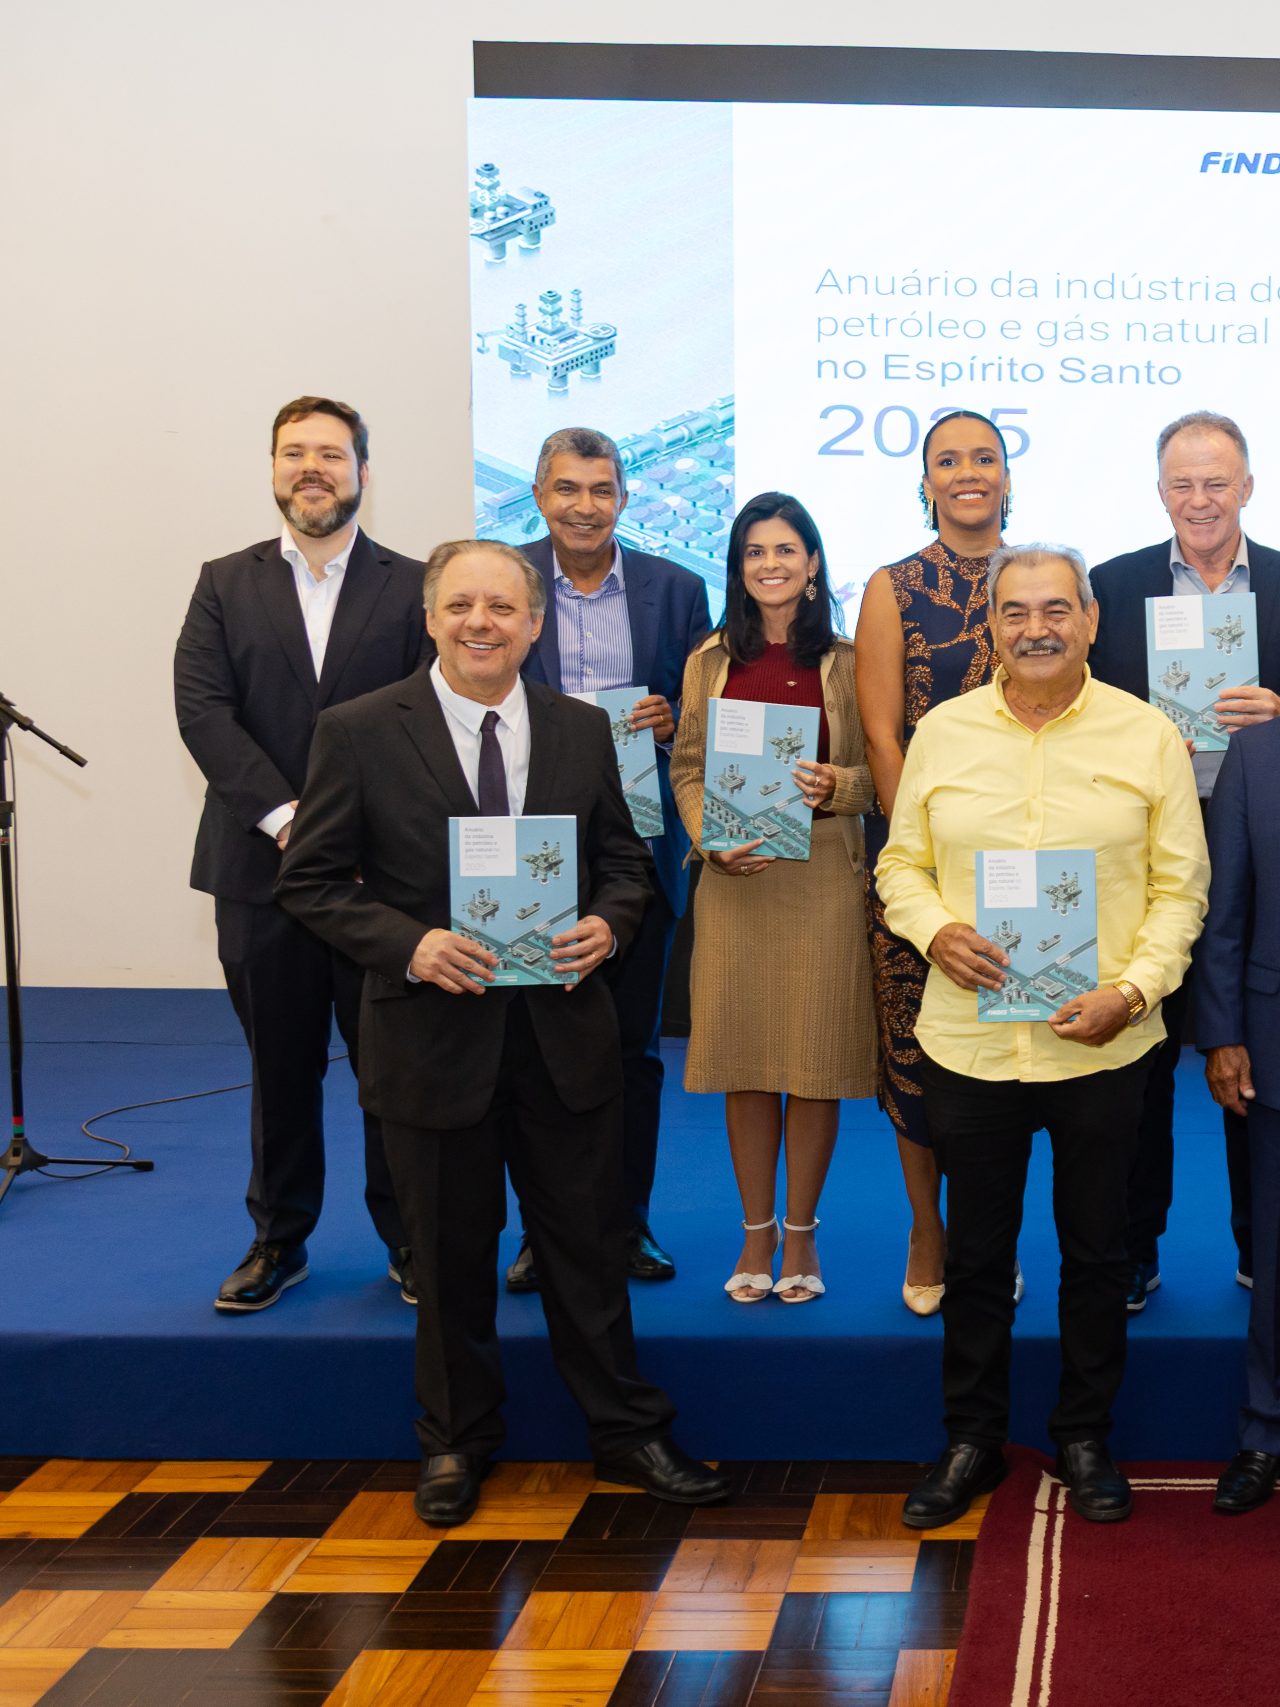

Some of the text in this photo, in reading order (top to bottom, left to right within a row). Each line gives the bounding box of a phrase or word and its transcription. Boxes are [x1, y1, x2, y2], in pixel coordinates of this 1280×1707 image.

[816, 267, 978, 298] Anuário
[991, 269, 1039, 299] da
[1055, 271, 1236, 304] indústria
[817, 310, 1269, 349] petróleo e gás natural
[817, 353, 1183, 389] no Espírito Santo
[817, 403, 1031, 461] 205
